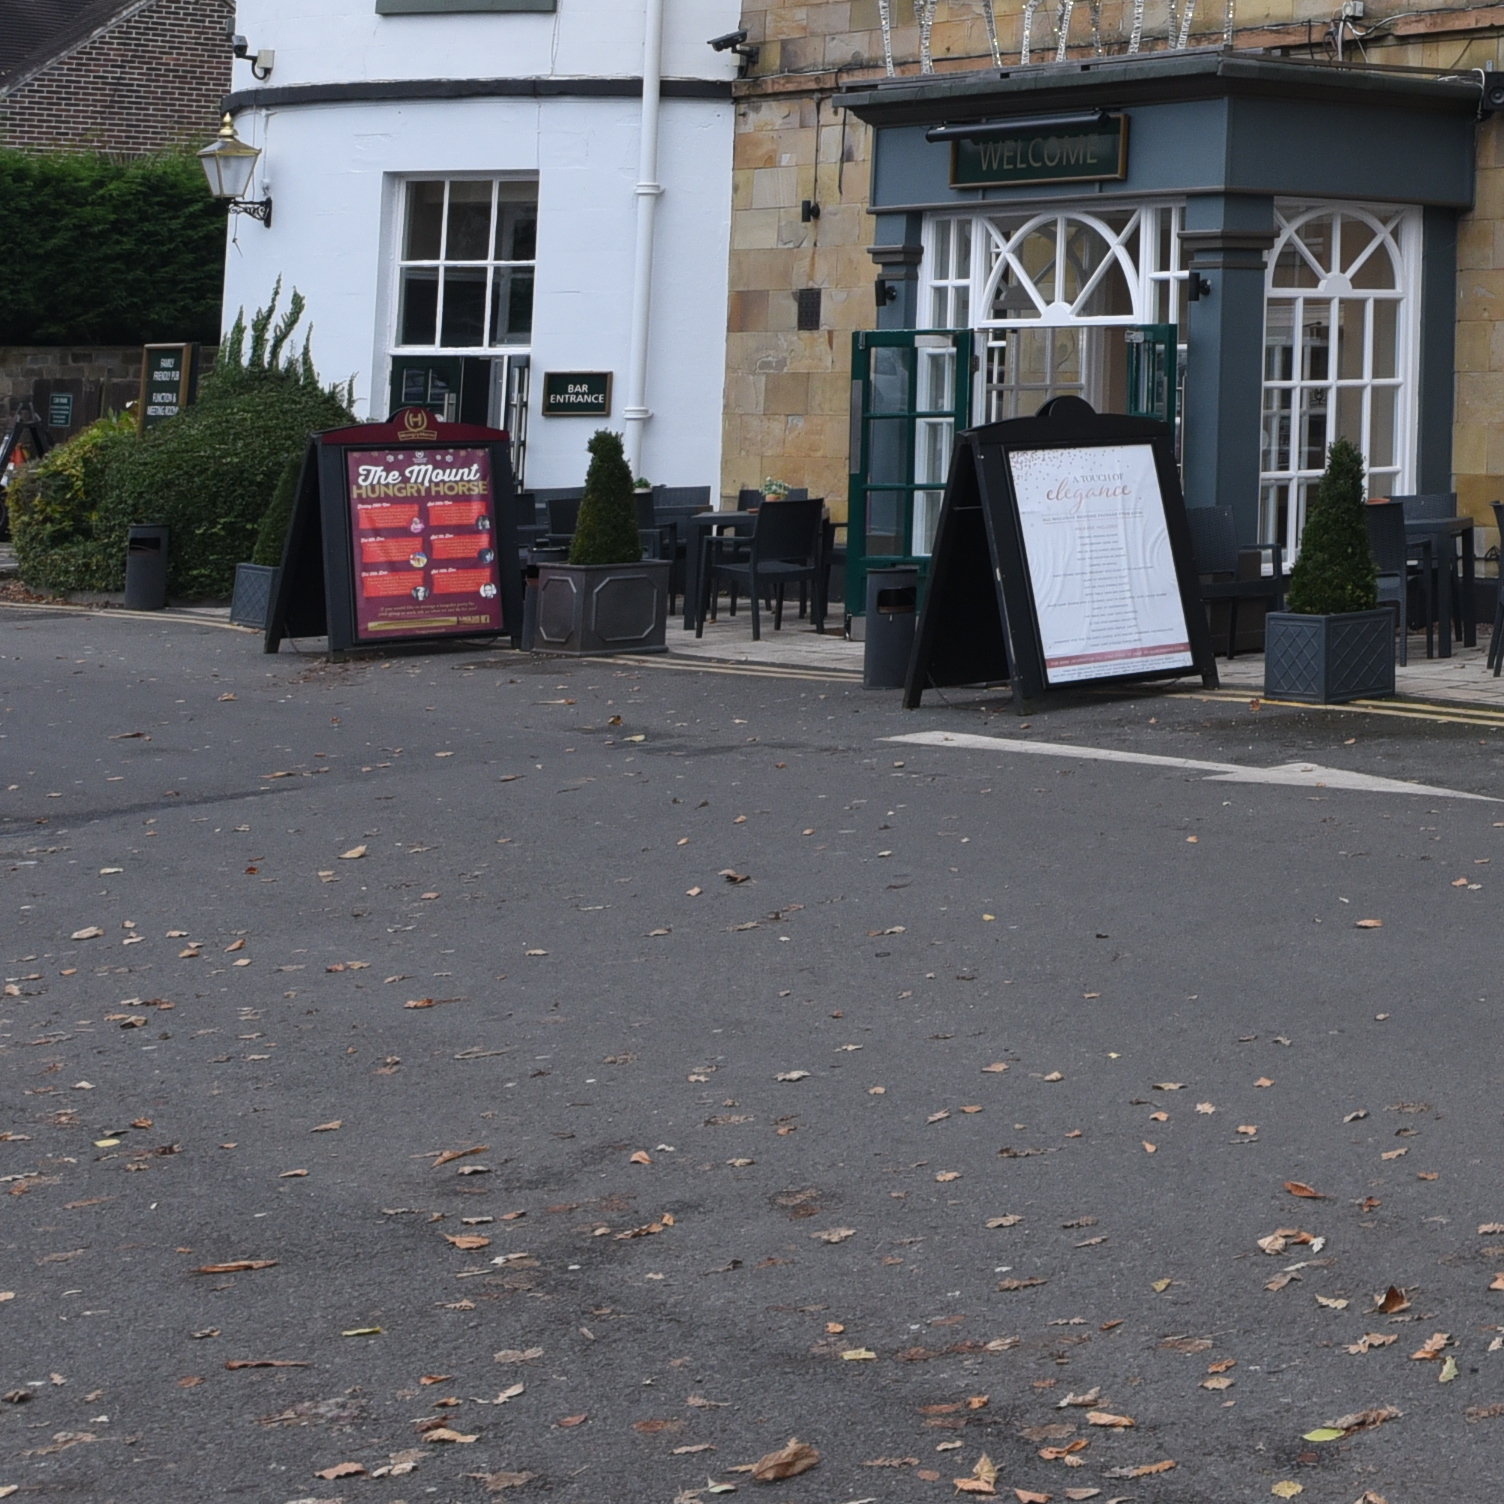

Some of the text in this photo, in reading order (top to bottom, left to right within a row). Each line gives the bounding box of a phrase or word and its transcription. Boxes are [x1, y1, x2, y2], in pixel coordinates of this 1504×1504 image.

[979, 133, 1098, 171] WELCOME
[567, 384, 589, 393] BAR
[549, 394, 605, 404] ENTRANCE
[357, 463, 481, 487] The Mount
[1072, 472, 1124, 484] A TOUCH OF
[352, 480, 489, 499] HUNGRY HORSE
[1046, 477, 1132, 515] elegance
